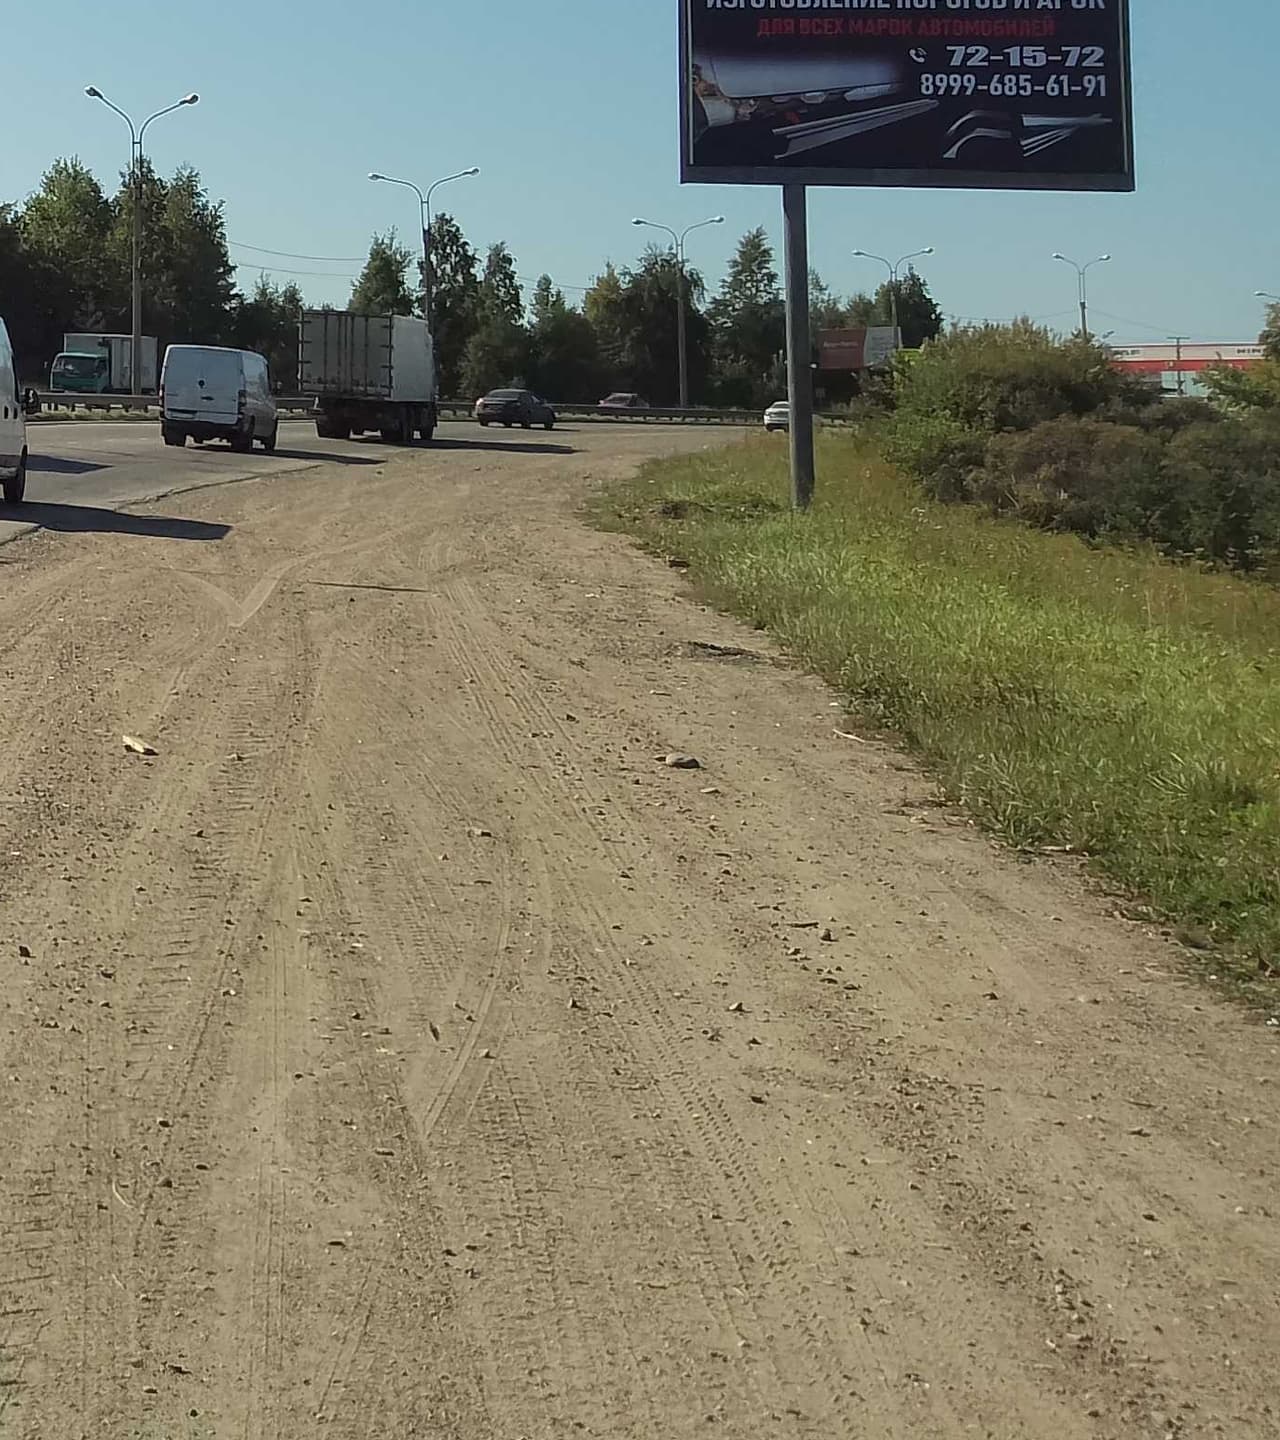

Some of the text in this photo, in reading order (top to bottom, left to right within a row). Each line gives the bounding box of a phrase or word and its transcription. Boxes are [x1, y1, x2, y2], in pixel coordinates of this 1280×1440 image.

[757, 16, 1056, 37] ДЛЯ ВСЕХ МАРОК АВТОМОБИЛЕЙ
[946, 45, 1105, 67] 72-15-72
[920, 73, 1107, 97] 8999-685-61-91
